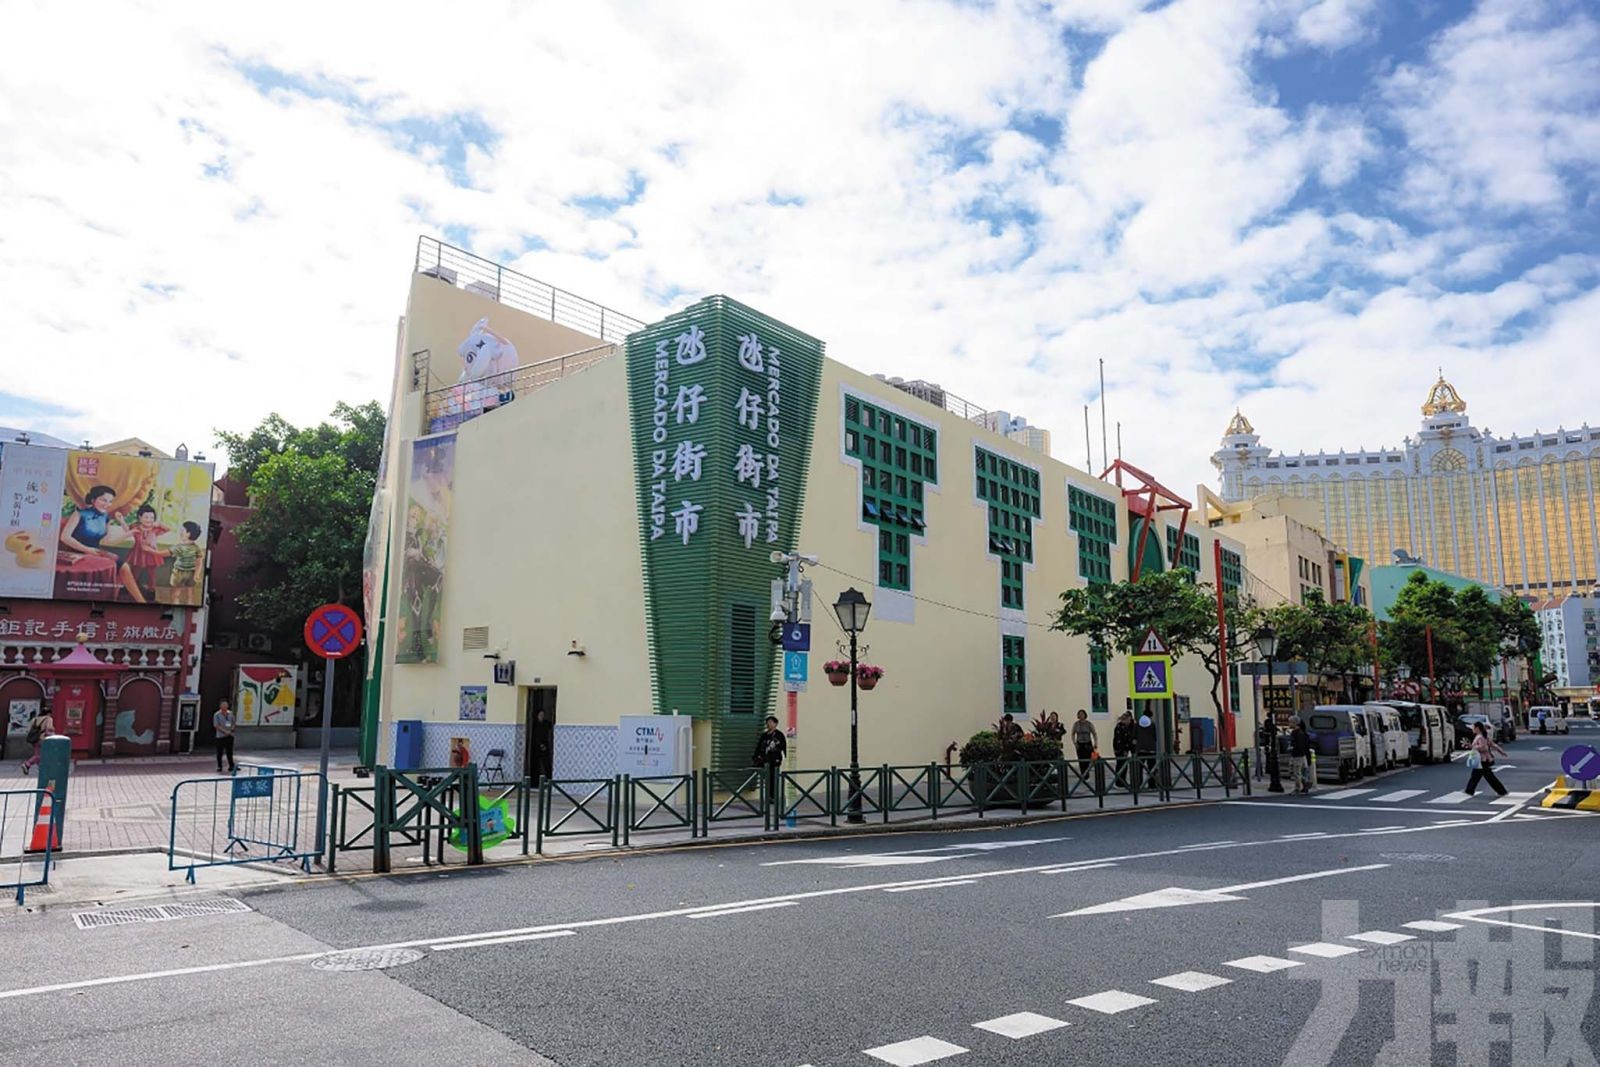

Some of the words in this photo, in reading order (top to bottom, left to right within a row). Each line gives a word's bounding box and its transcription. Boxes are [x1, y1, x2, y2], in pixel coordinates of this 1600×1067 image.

[652, 339, 669, 443] MERCADO
[767, 346, 781, 449] MERCADO
[652, 451, 667, 478] DA
[766, 454, 779, 481] DA
[650, 480, 666, 541] TAIPA
[766, 487, 779, 543] TAIPA
[635, 727, 655, 736] CTM
